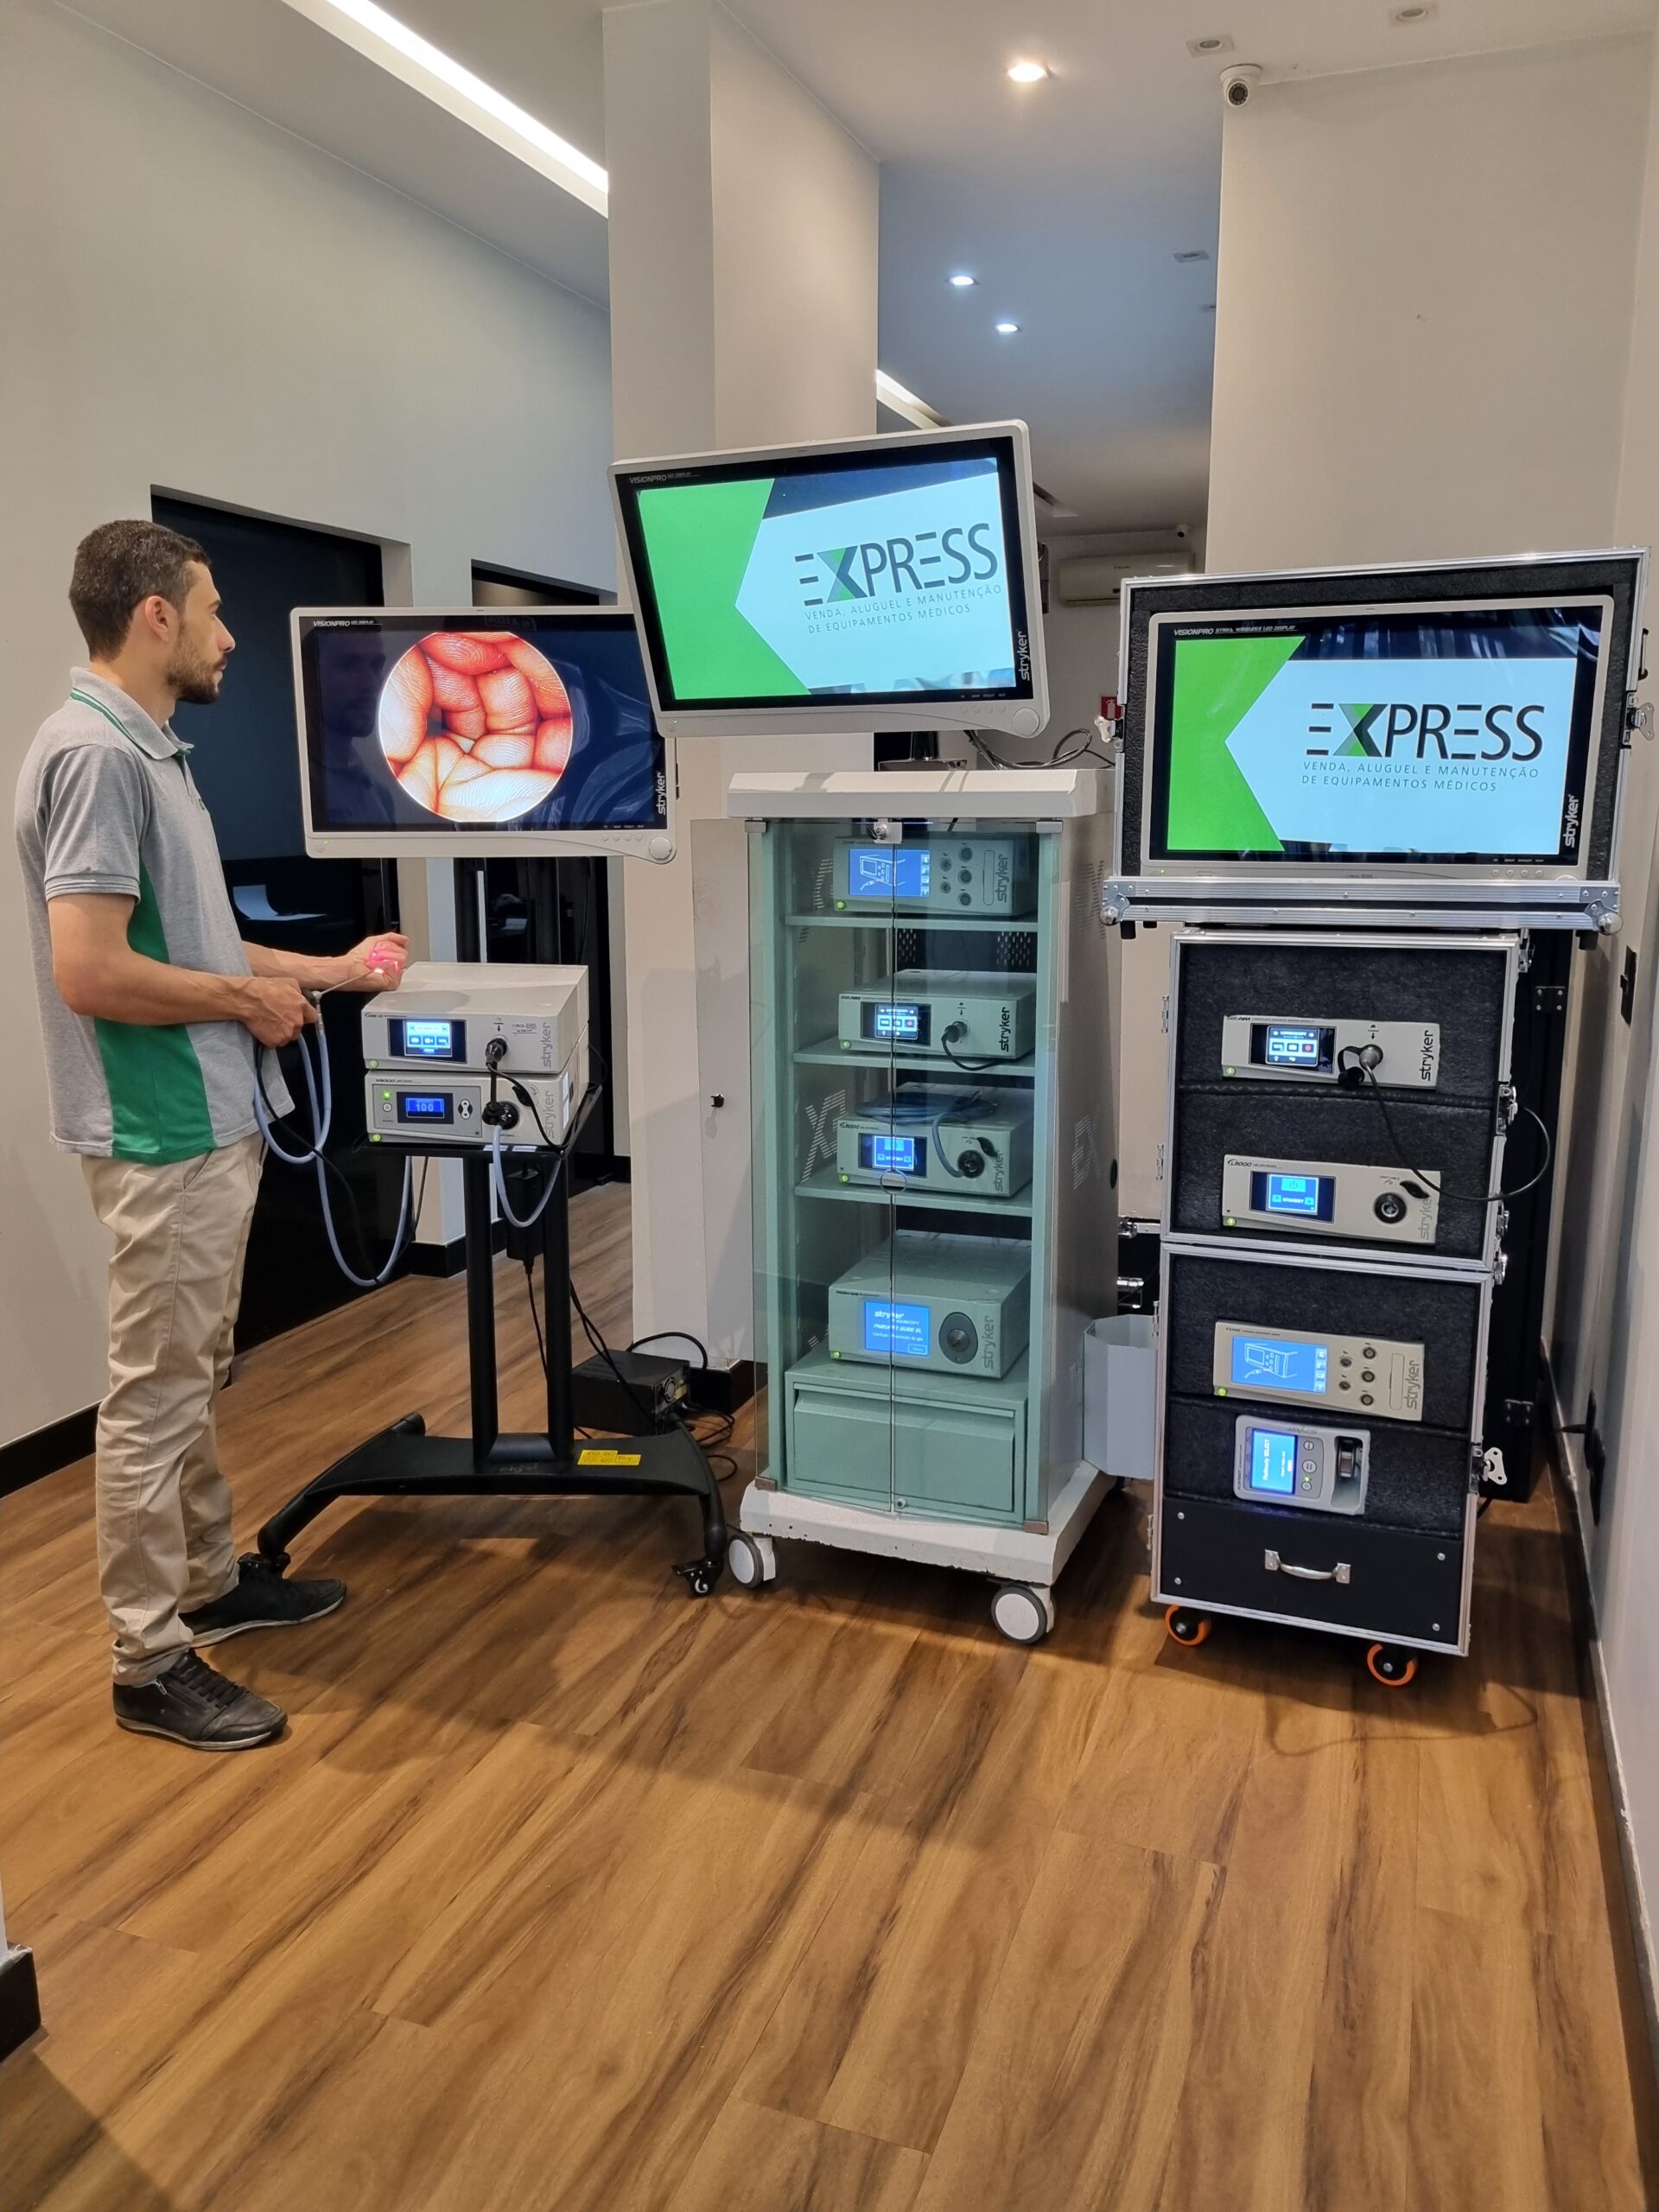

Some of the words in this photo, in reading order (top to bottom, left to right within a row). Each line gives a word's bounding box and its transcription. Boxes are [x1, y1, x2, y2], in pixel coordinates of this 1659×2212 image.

[629, 474, 667, 485] VISIONPRO
[794, 523, 999, 607] EXPRESS
[805, 608, 846, 621] VENDA,
[851, 600, 901, 615] ALUGUEL
[906, 597, 912, 607] E
[918, 584, 1002, 606] MANUTENÇÃO
[808, 624, 822, 634] DE
[827, 608, 913, 632] EQUIPAMENTOS
[918, 603, 971, 620] MÉDICOS
[1016, 630, 1030, 682] stryker
[1306, 702, 1545, 761] EXPRESS
[1301, 775, 1317, 785] DE
[1324, 776, 1427, 790] EQUIPAMENTOS
[1434, 779, 1497, 792] MÉDICOS
[1303, 761, 1351, 773] VENDA,
[1357, 763, 1418, 775] ALUGUEL
[1426, 765, 1432, 775] E
[1438, 766, 1539, 779] MANUTENÇÃO
[655, 772, 666, 816] stryker
[1563, 795, 1579, 848] stryker
[995, 854, 1010, 903] stryker
[540, 1022, 553, 1068] stryker
[999, 1007, 1011, 1052] stryker
[1420, 1030, 1433, 1082] stryker
[416, 1103, 434, 1112] 100
[543, 1090, 556, 1139] stryker
[1418, 1197, 1433, 1240] stryke
[982, 1315, 995, 1370] stryker
[1404, 1360, 1421, 1410] stryker
